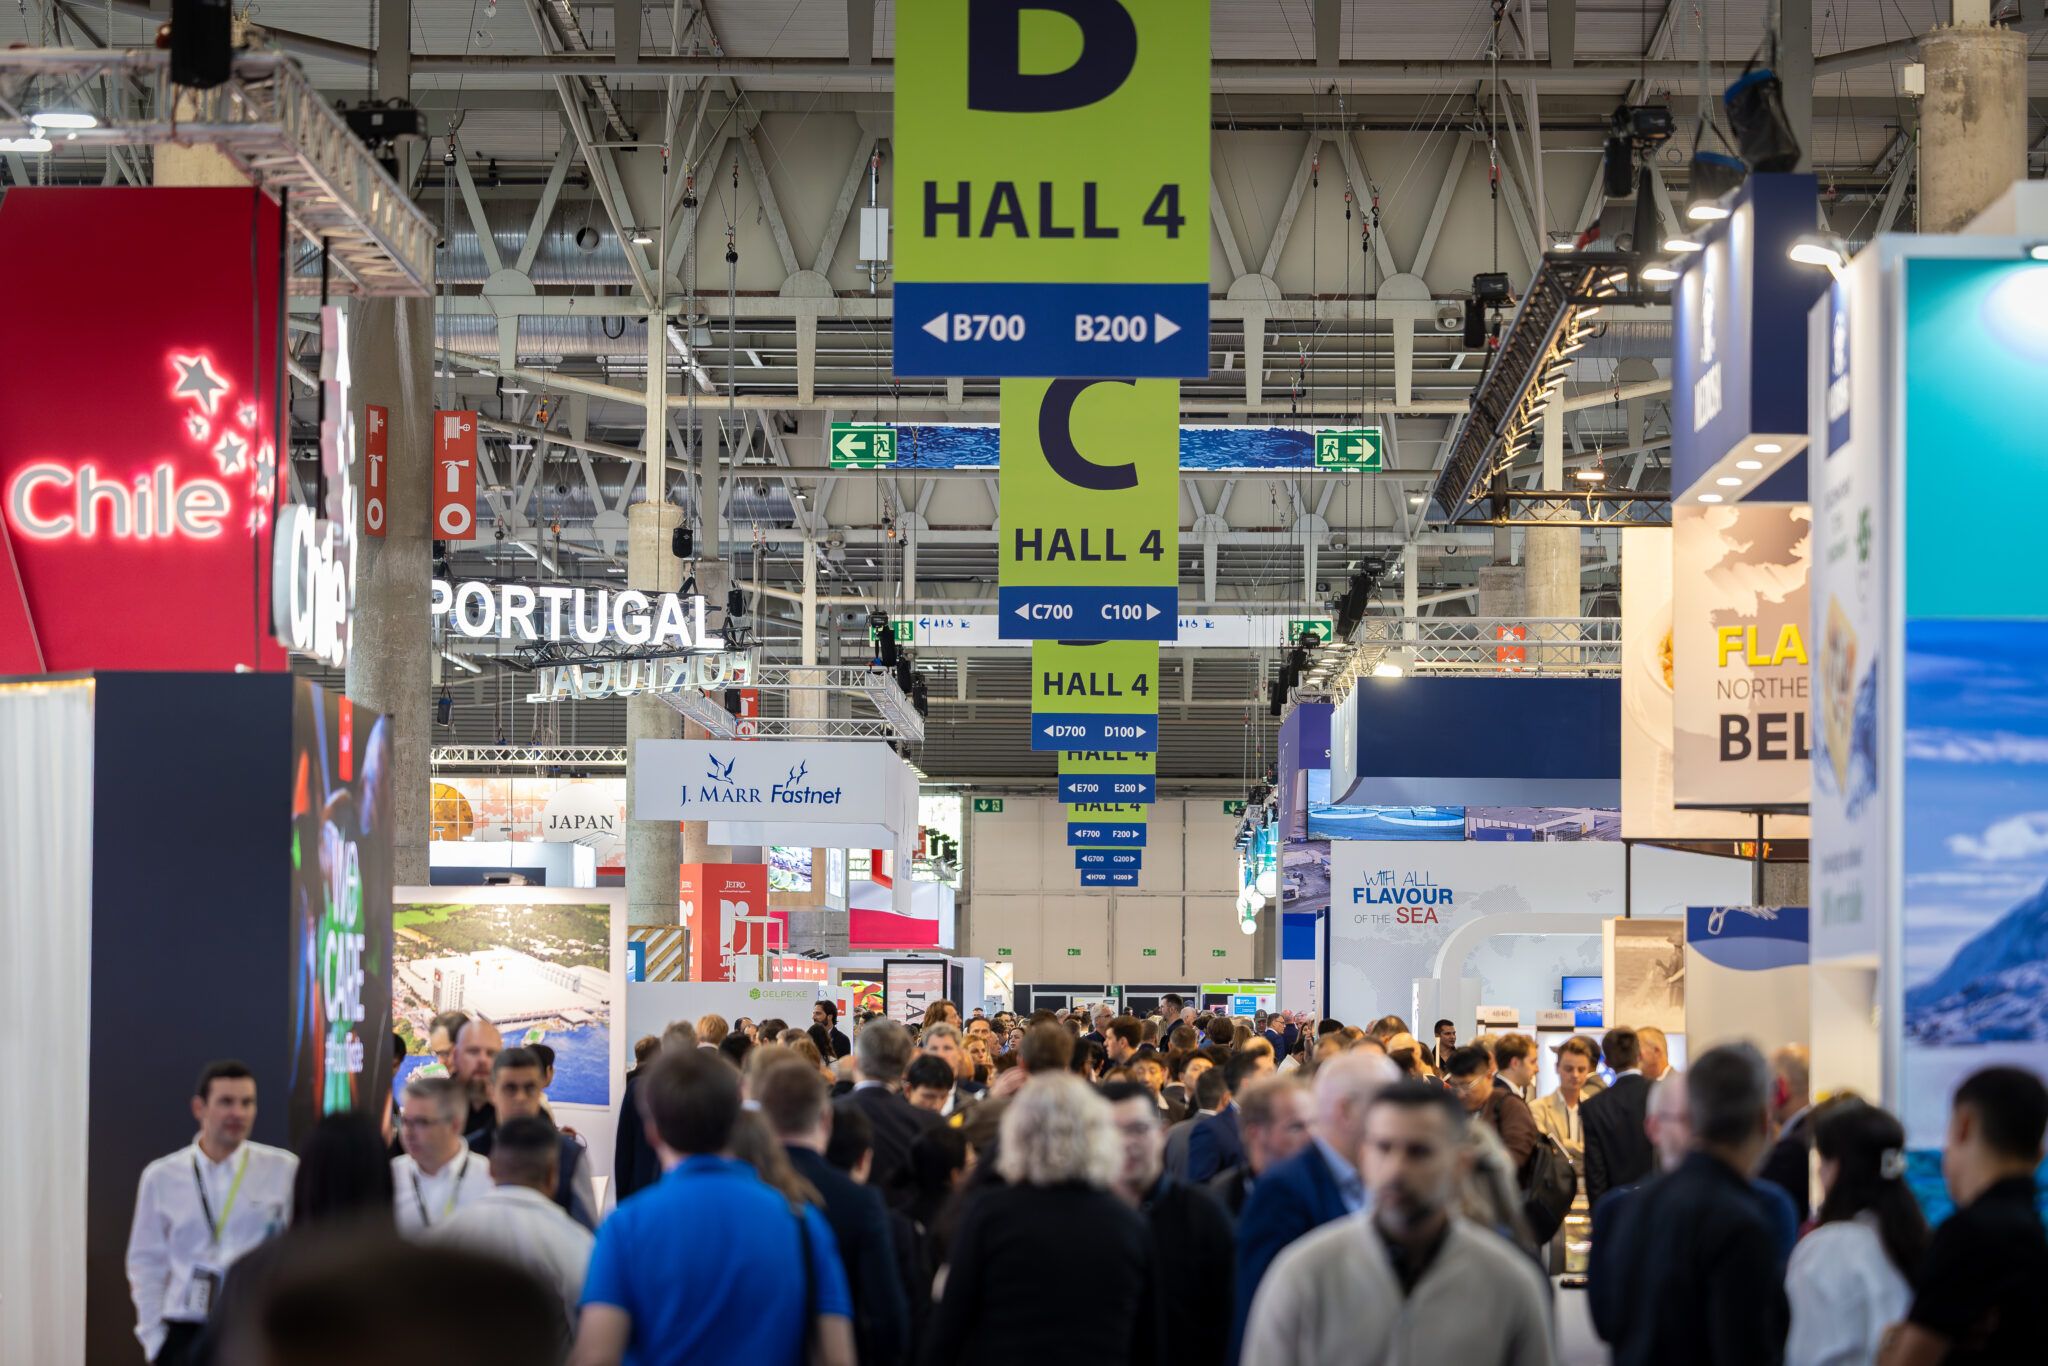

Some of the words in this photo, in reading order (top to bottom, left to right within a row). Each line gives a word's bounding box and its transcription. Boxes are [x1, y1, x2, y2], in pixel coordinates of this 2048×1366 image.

[923, 181, 1119, 239] HALL
[1142, 183, 1185, 239] 4
[953, 314, 1026, 341] B700
[1075, 314, 1147, 342] B200
[1037, 378, 1139, 491] C
[11, 463, 228, 538] Chile
[1015, 528, 1126, 561] HALL
[1139, 529, 1165, 561] 4
[289, 503, 347, 667] Chile
[432, 579, 724, 649] PORTUGAL
[1032, 604, 1073, 620] C700
[1101, 604, 1142, 620] C100
[1717, 624, 1809, 667] FLA
[1043, 672, 1122, 696] HALL
[1131, 673, 1149, 696] 4
[1717, 676, 1809, 700] NORTHE
[1055, 725, 1086, 738] D700
[1104, 726, 1134, 738] D100
[680, 785, 692, 807] J.
[700, 785, 762, 803] MARR
[771, 784, 842, 804] Fastnet
[1077, 784, 1099, 792] E700
[1114, 784, 1136, 792] E200
[549, 815, 615, 829] JAPAN
[1112, 830, 1131, 838] F200
[1363, 870, 1395, 886] WITH
[1403, 870, 1438, 886] ALL
[1353, 887, 1453, 905] FLAVOUR
[1354, 914, 1368, 924] OF
[1371, 914, 1391, 924] THE
[1396, 907, 1439, 924] SEA
[324, 928, 366, 1023] CARE
[762, 990, 808, 998] GELPEIXE
